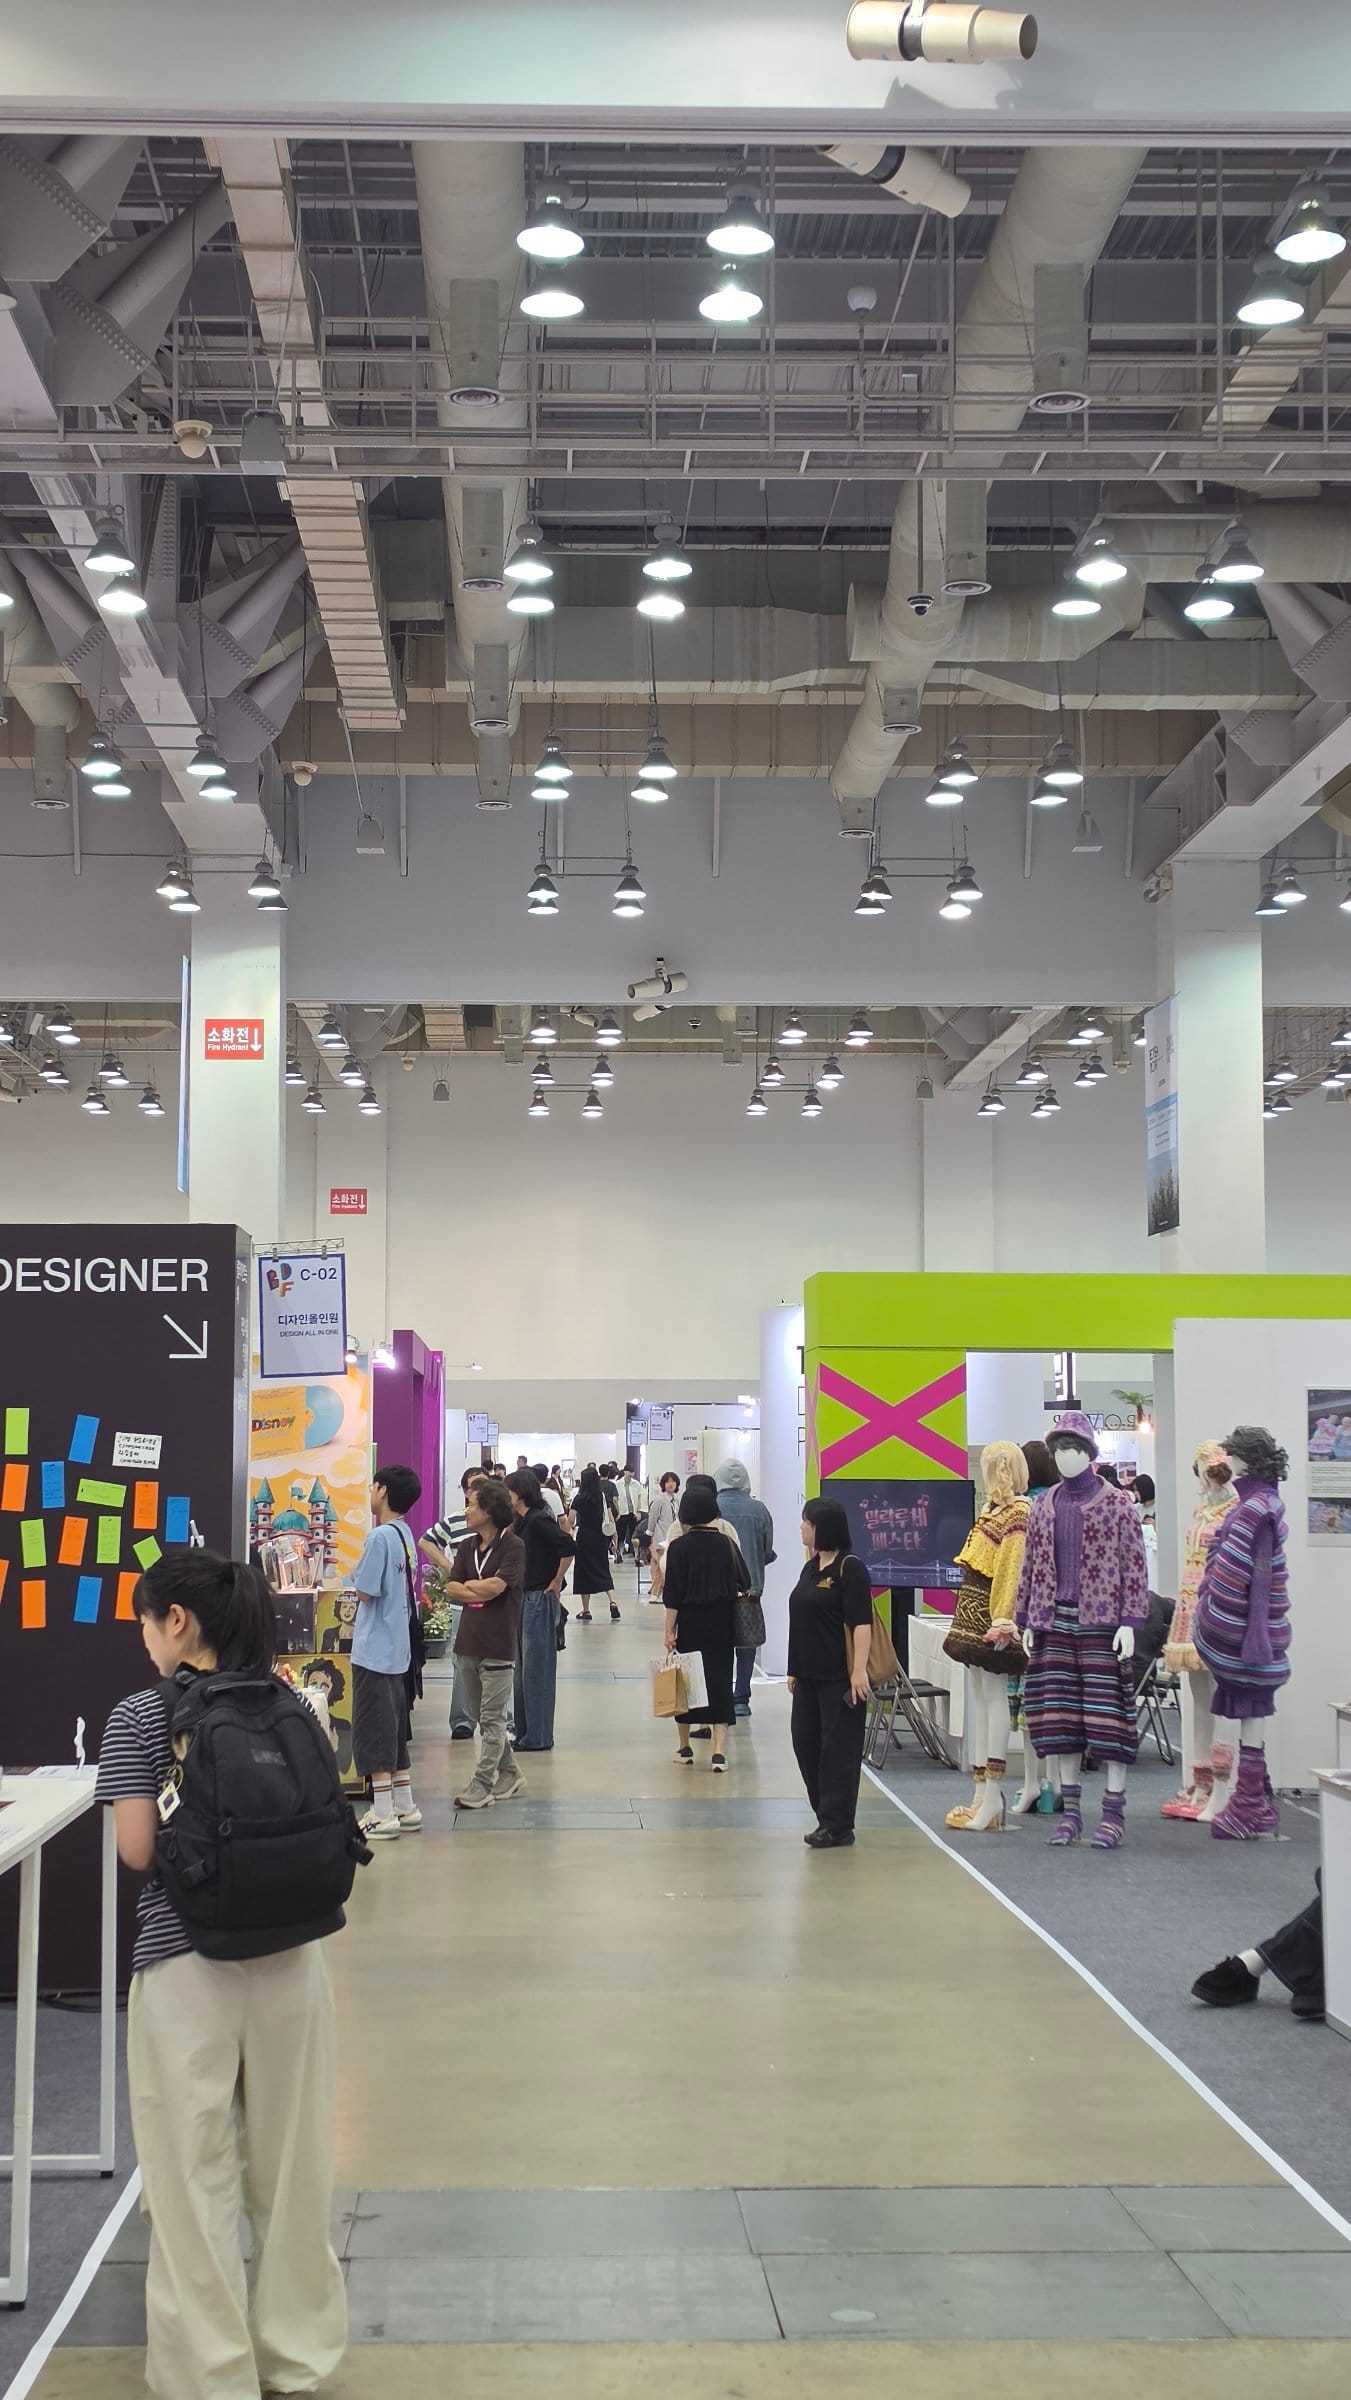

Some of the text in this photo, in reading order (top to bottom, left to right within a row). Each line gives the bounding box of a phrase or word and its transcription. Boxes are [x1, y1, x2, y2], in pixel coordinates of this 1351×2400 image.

[207, 1026, 249, 1044] 소화전
[207, 1043, 249, 1052] Fire Hydrant
[331, 1193, 358, 1205] 소화전
[300, 1267, 337, 1281] C-02
[278, 1312, 339, 1326] 디자인올인원
[280, 1330, 304, 1338] DESIGN
[325, 1328, 339, 1336] ONE
